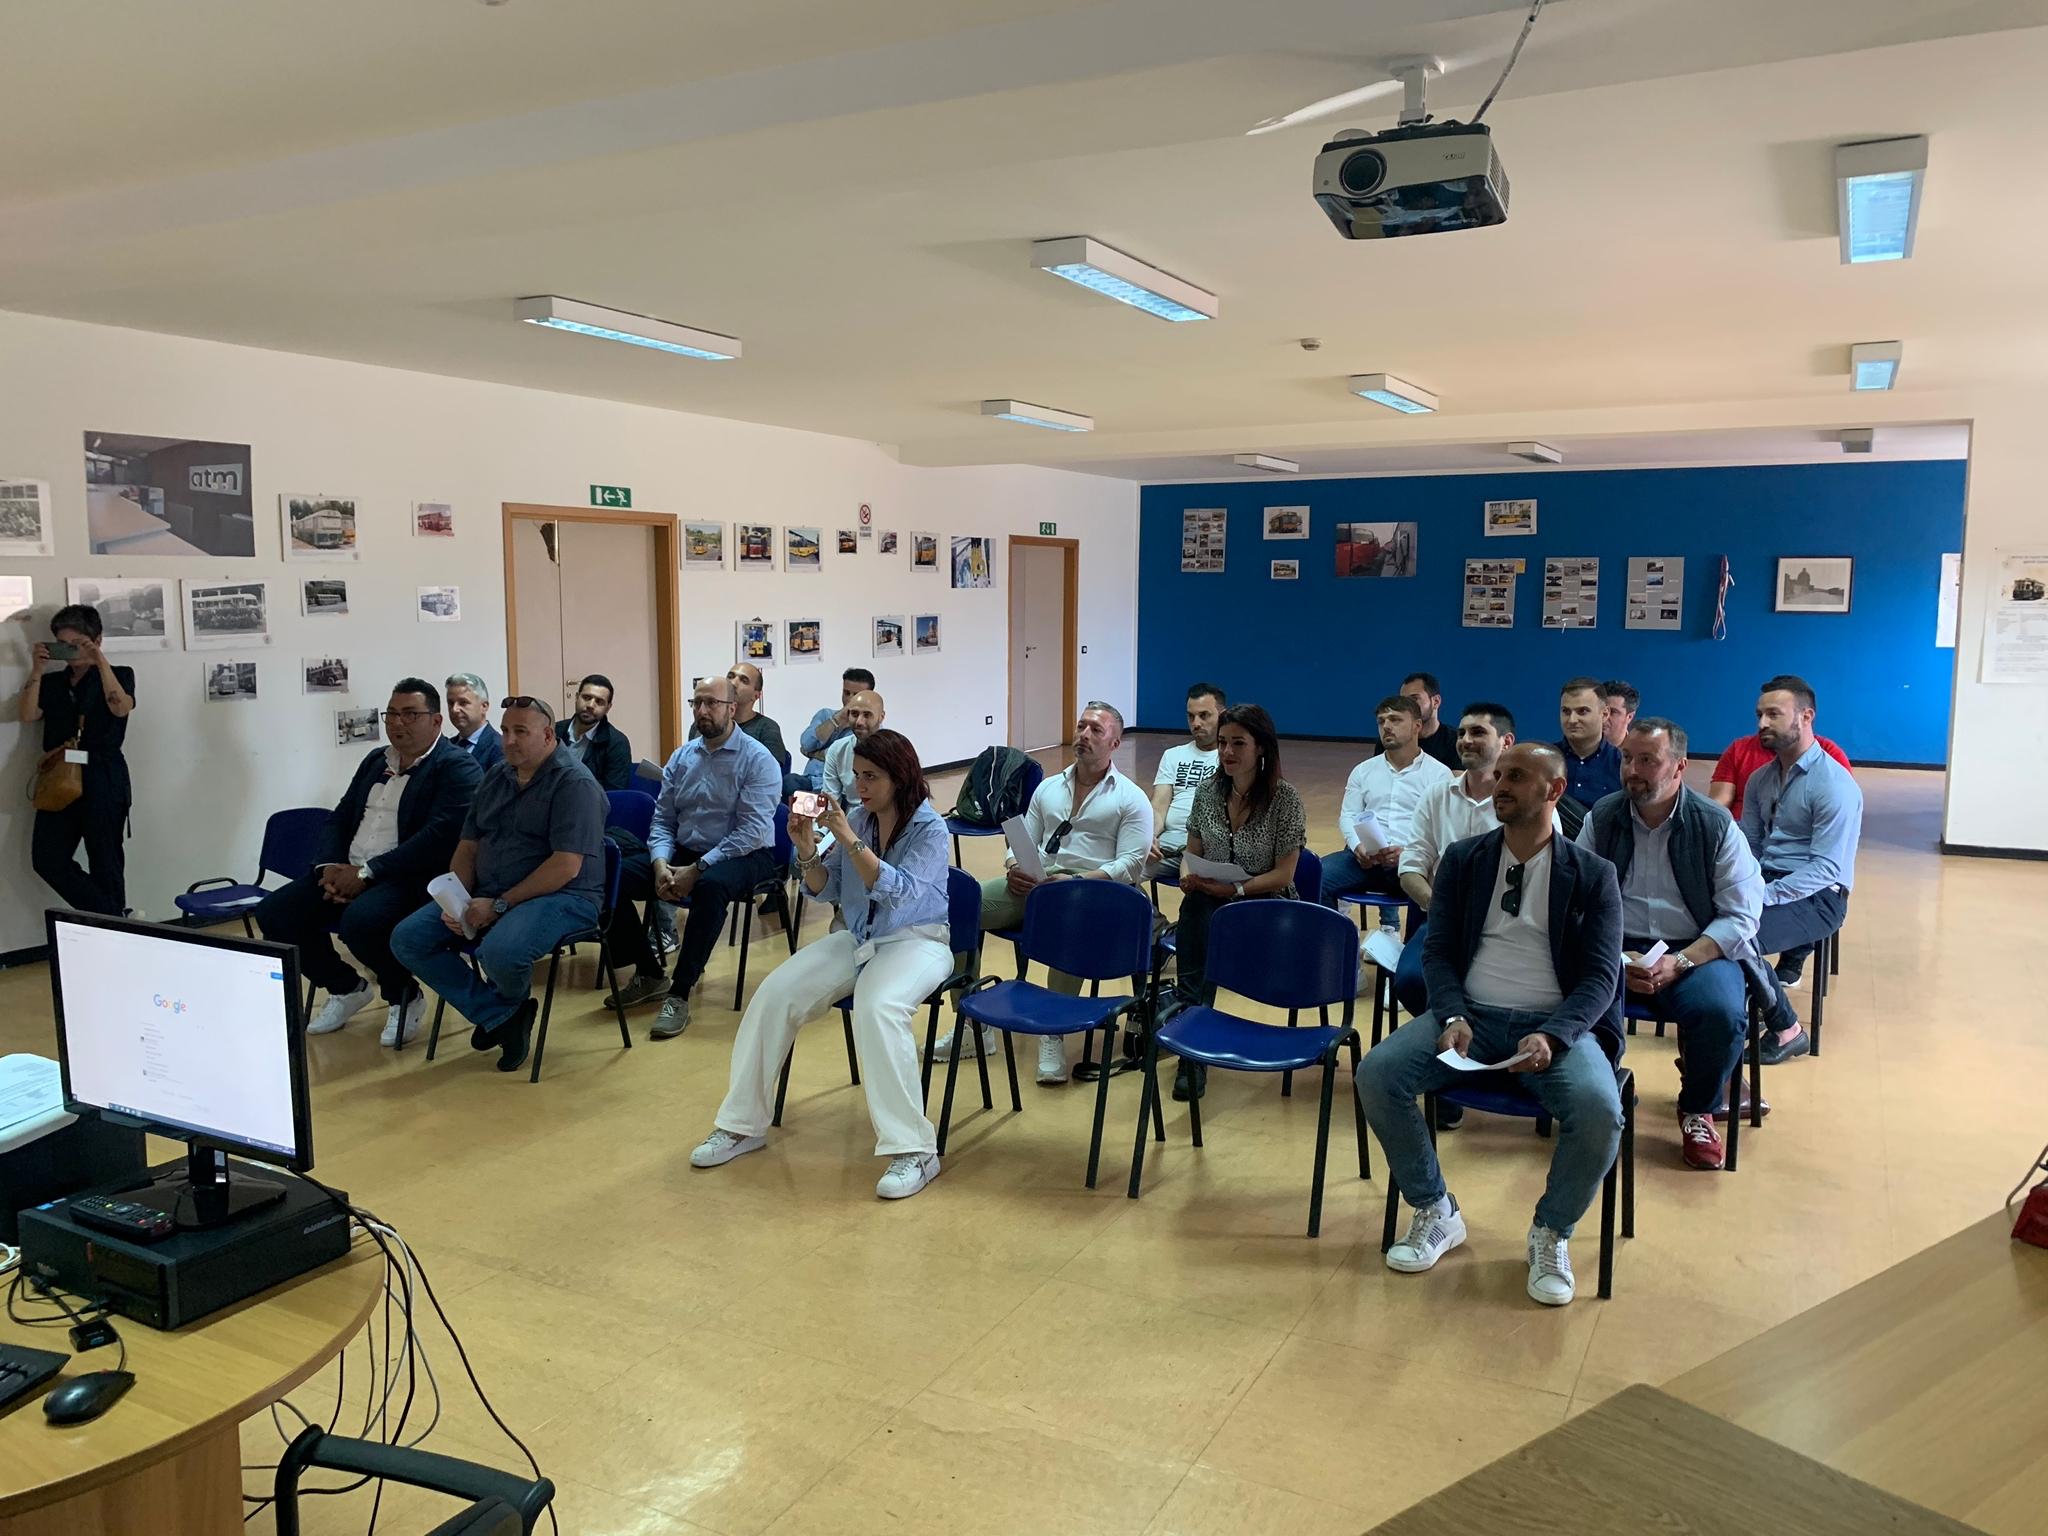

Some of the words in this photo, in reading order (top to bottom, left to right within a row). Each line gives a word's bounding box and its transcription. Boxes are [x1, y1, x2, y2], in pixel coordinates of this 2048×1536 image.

[191, 468, 238, 491] atm
[1174, 761, 1192, 787] MORE
[1185, 760, 1205, 789] TALENT
